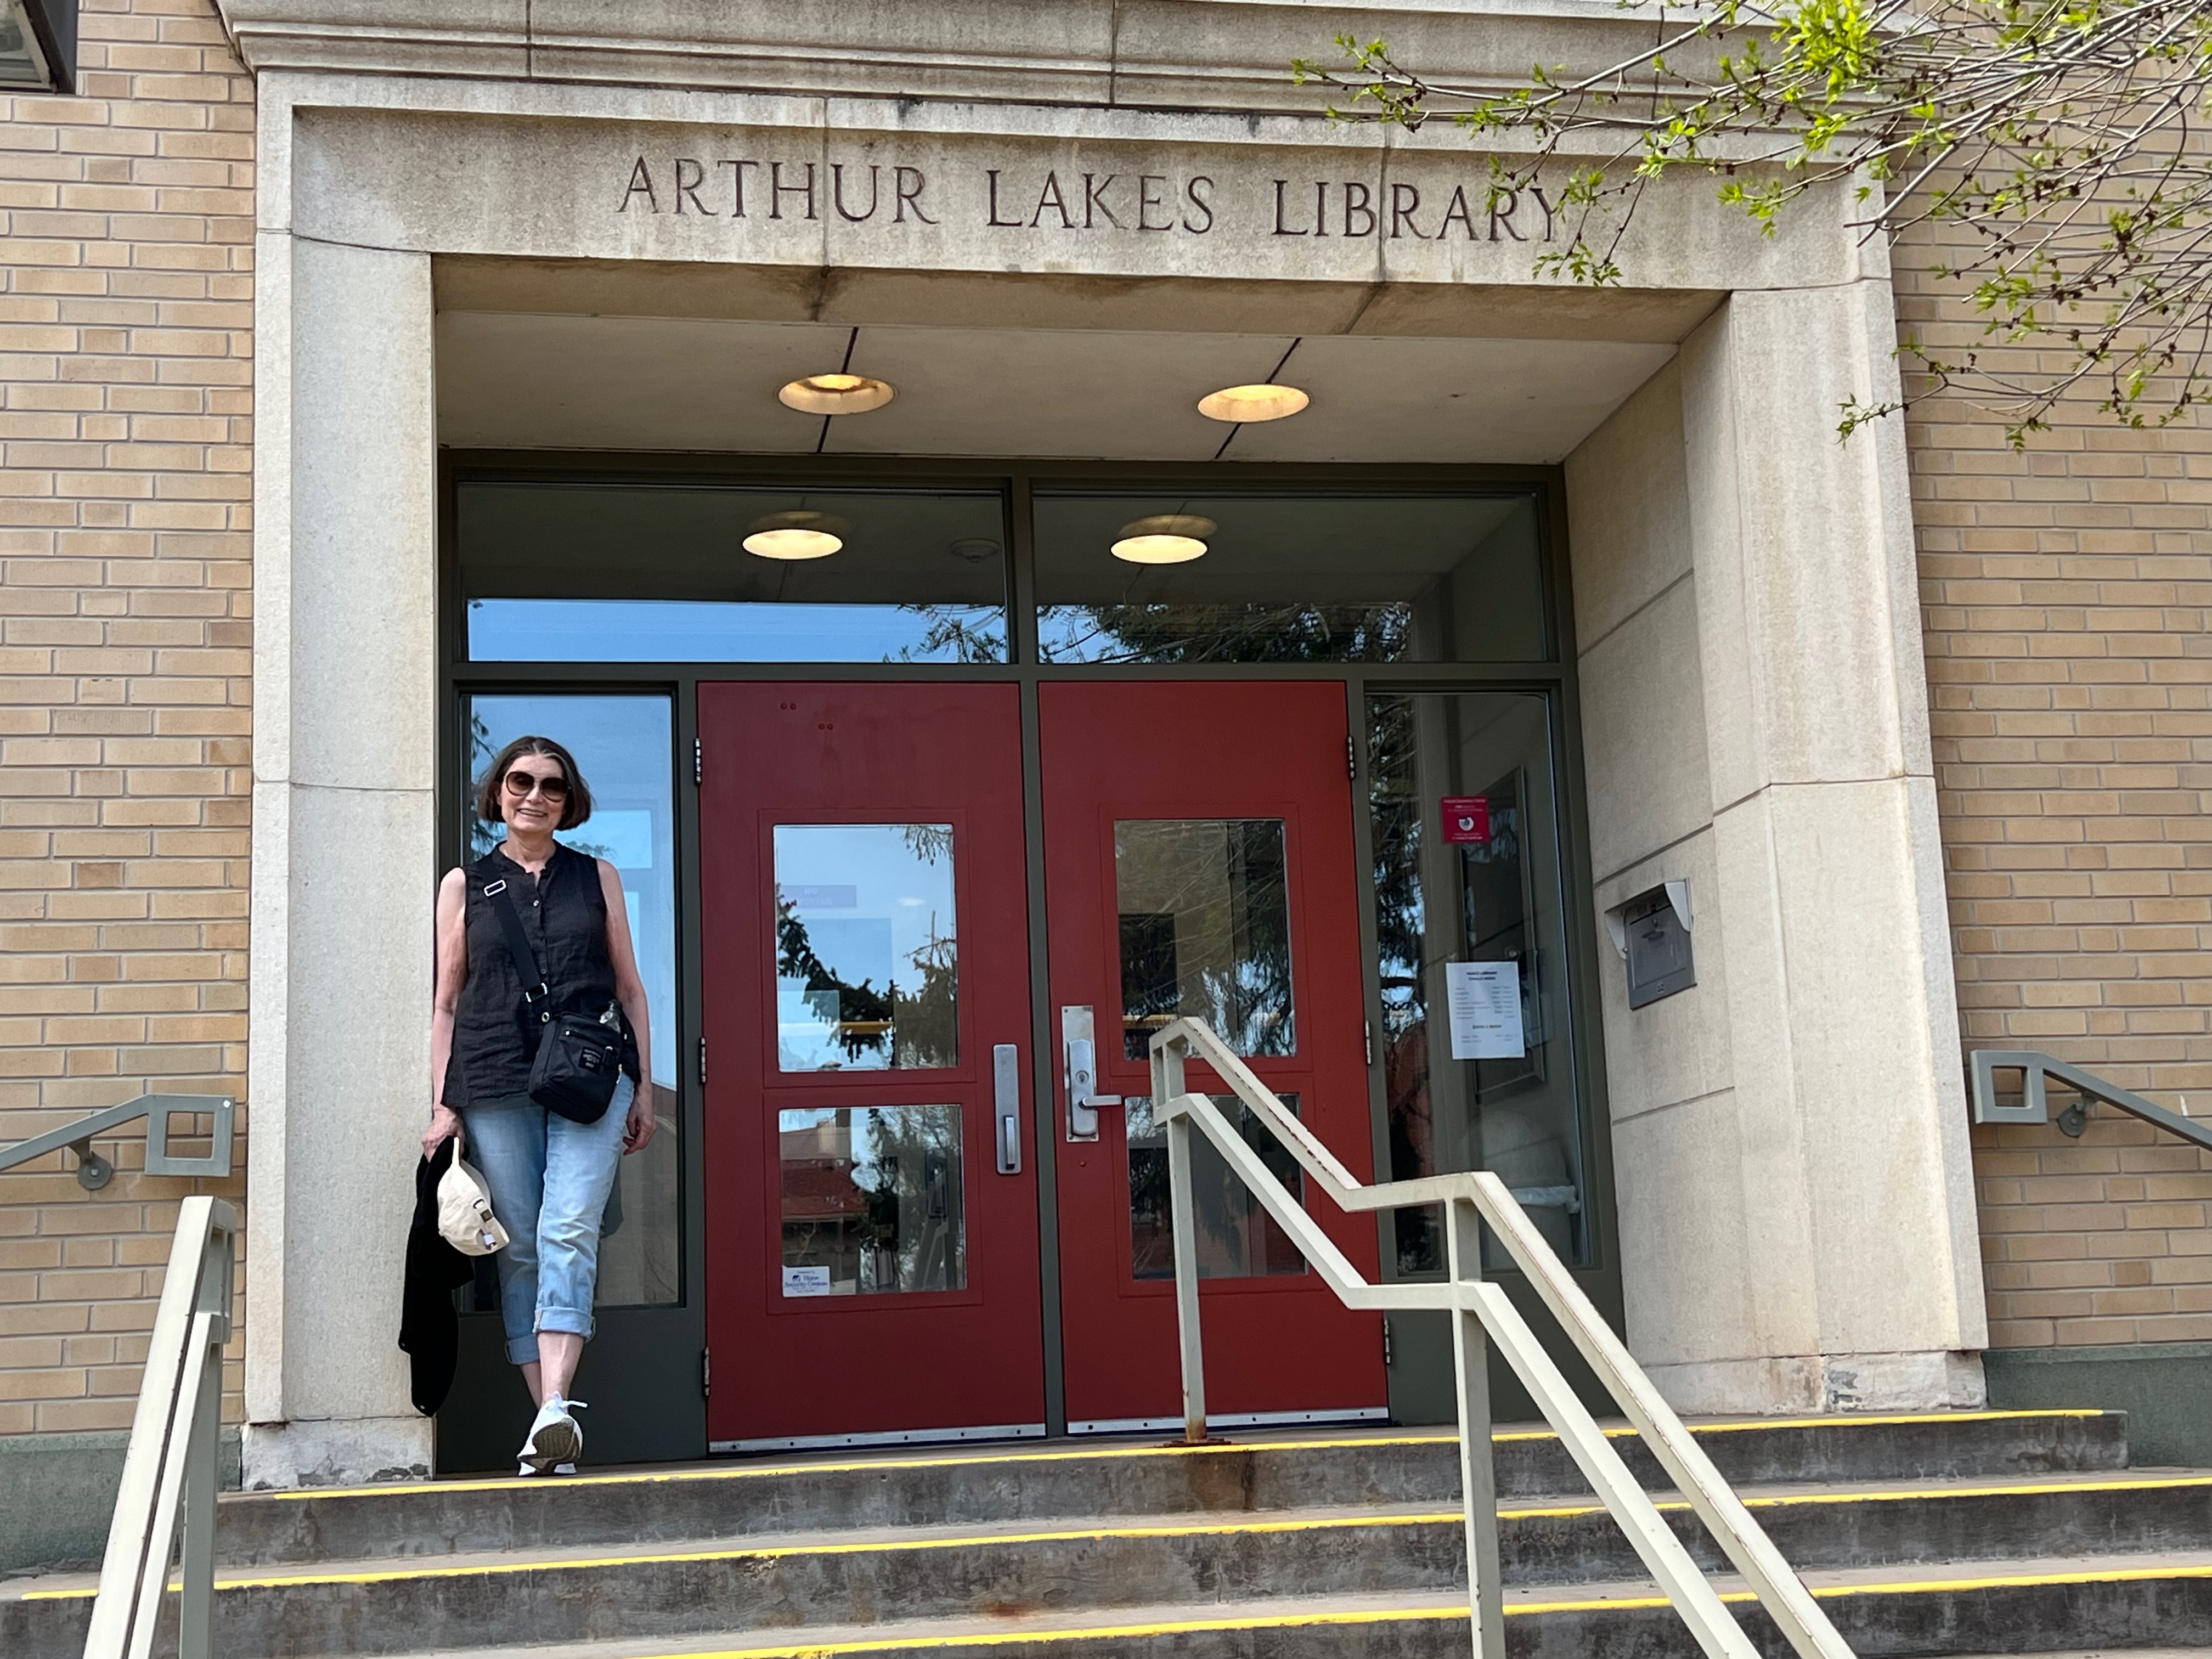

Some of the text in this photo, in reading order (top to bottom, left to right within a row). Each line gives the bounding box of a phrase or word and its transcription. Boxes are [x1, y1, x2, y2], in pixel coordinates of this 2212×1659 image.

[615, 155, 1571, 242] ARTHUR LAKES LIBRARY
